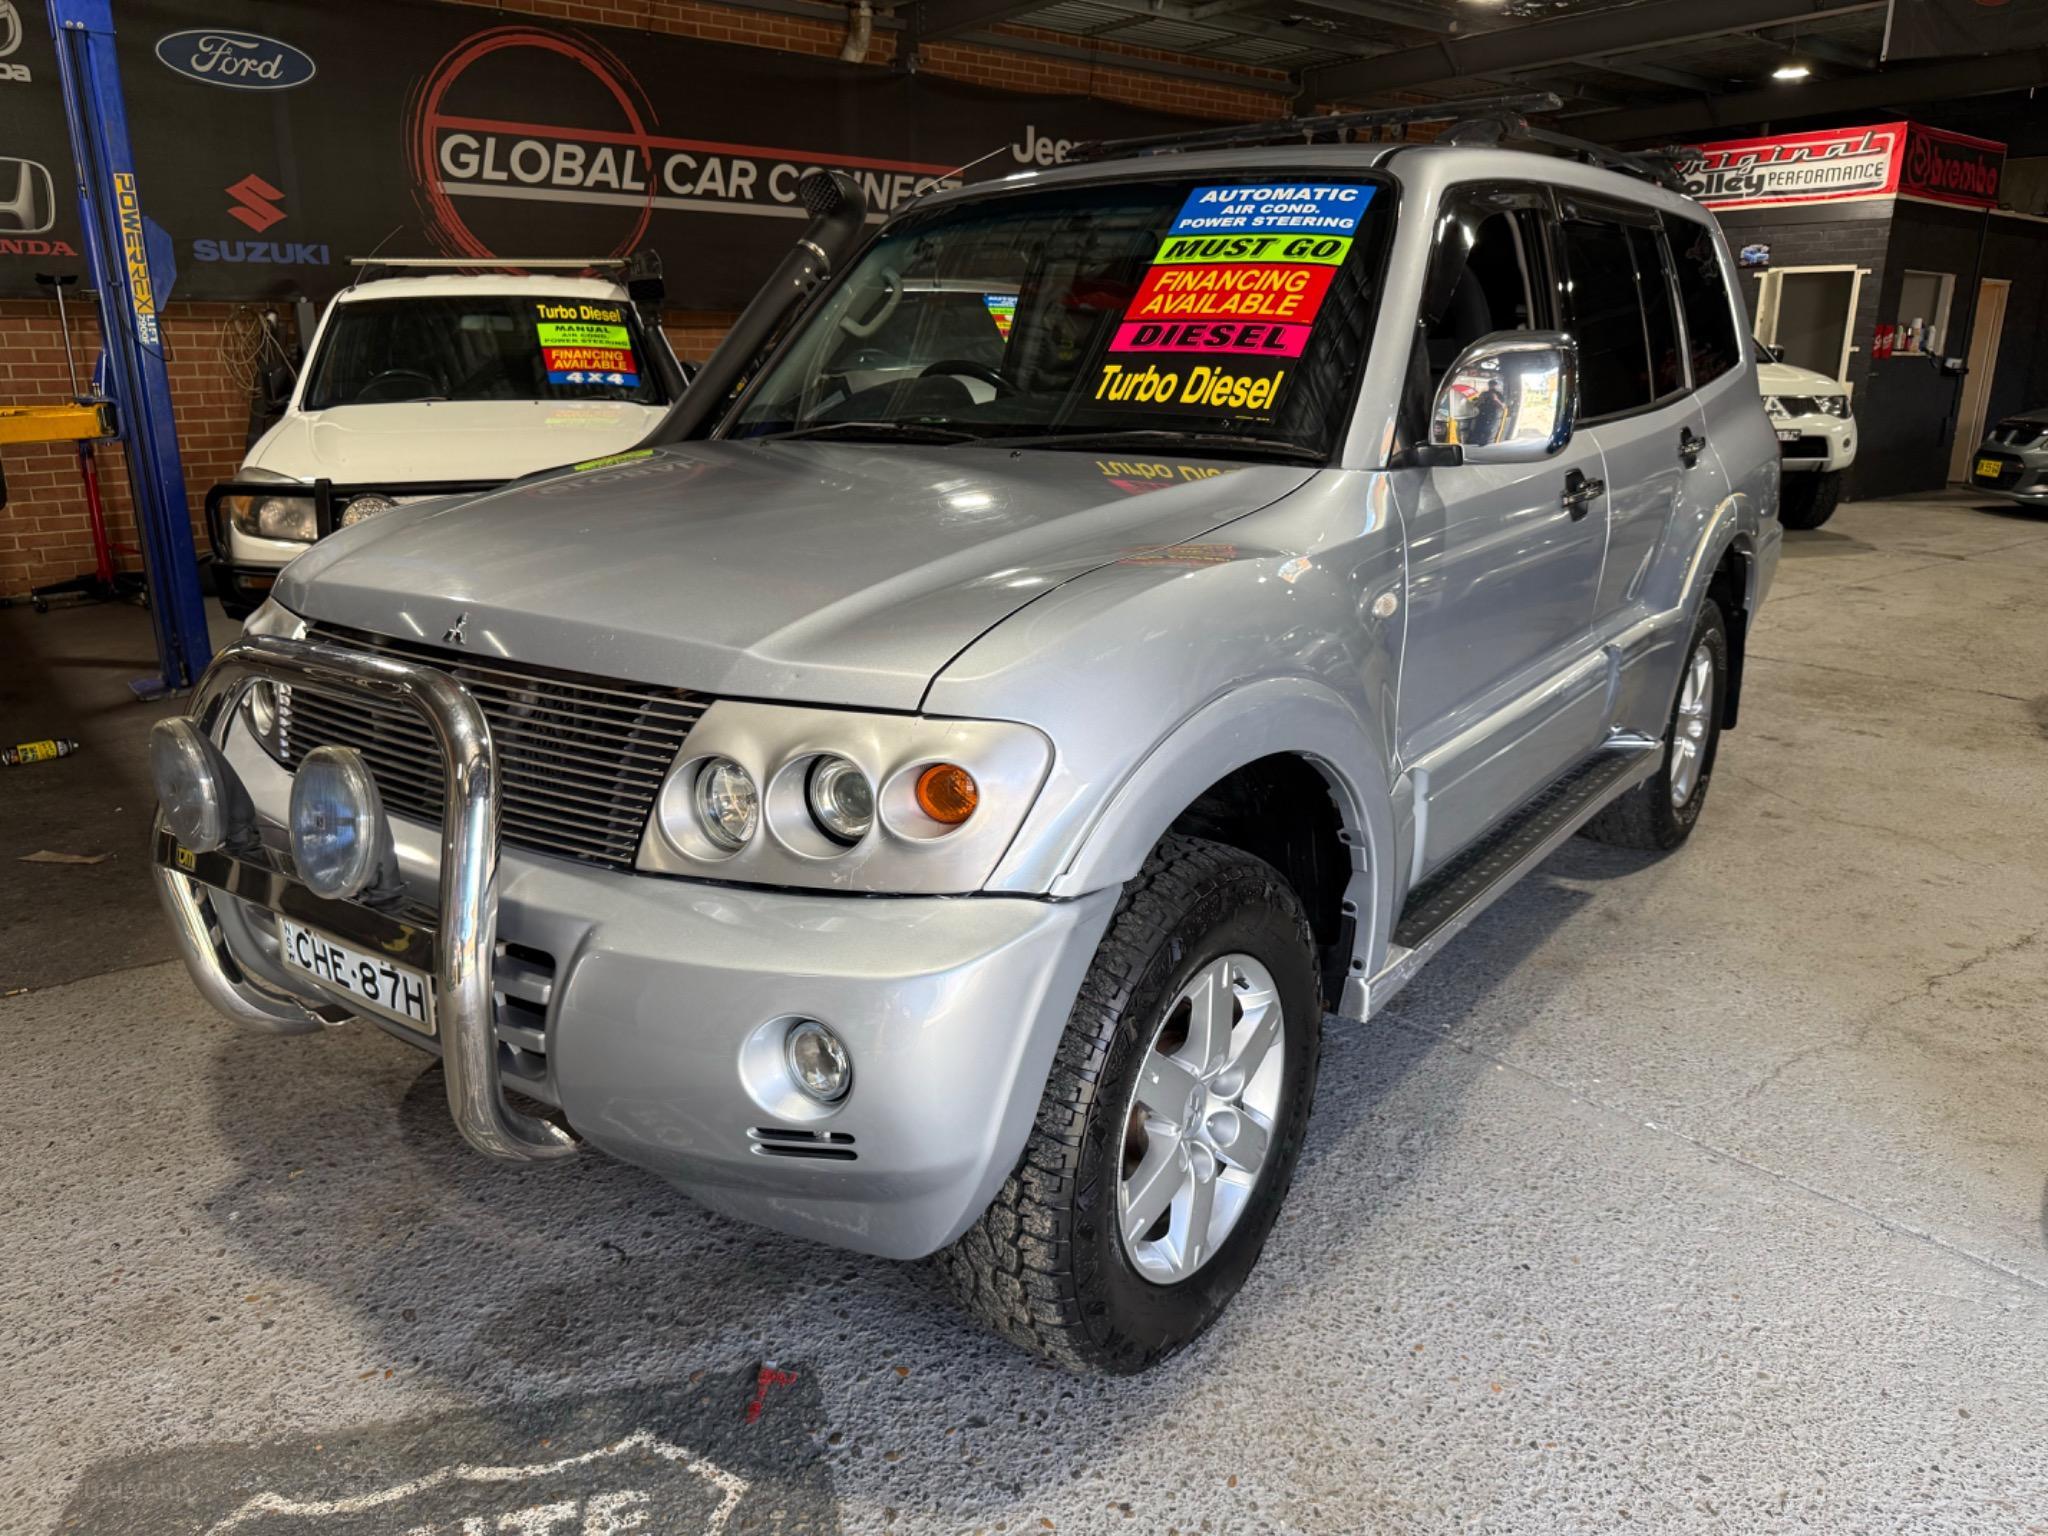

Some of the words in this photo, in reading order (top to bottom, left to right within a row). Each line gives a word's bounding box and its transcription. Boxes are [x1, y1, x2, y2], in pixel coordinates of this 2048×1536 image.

[190, 34, 284, 81] Ford
[1012, 124, 1083, 166] Jee
[1676, 130, 1882, 176] riginal
[440, 133, 645, 191] GLOBAL
[663, 153, 758, 200] CAR
[1681, 173, 1766, 198] olley
[1767, 161, 1885, 186] PERFORMANCE
[1929, 145, 1998, 196] brembo
[1199, 188, 1359, 204] AUTOMATIC
[1221, 204, 1255, 215] AIR
[1260, 203, 1321, 214] COND.
[1179, 217, 1246, 229] POWER
[1251, 215, 1355, 229] STEERING
[115, 174, 154, 315] POWERREX
[193, 239, 330, 265] SUZUKI
[1162, 237, 1281, 261] MUST
[1282, 237, 1344, 260] GO
[1153, 269, 1311, 292] FINANCING
[536, 303, 578, 320] Turbo
[580, 305, 622, 323] Diesel
[1140, 293, 1305, 316] AVAILABLE
[145, 315, 159, 345] LIFT
[555, 325, 611, 334] MANUAL
[1129, 324, 1288, 350] DIESEL
[551, 350, 624, 361] FINANCING
[554, 359, 628, 371] AVAILABLE
[1095, 363, 1179, 404] Turbo
[1179, 365, 1285, 410] Diesel
